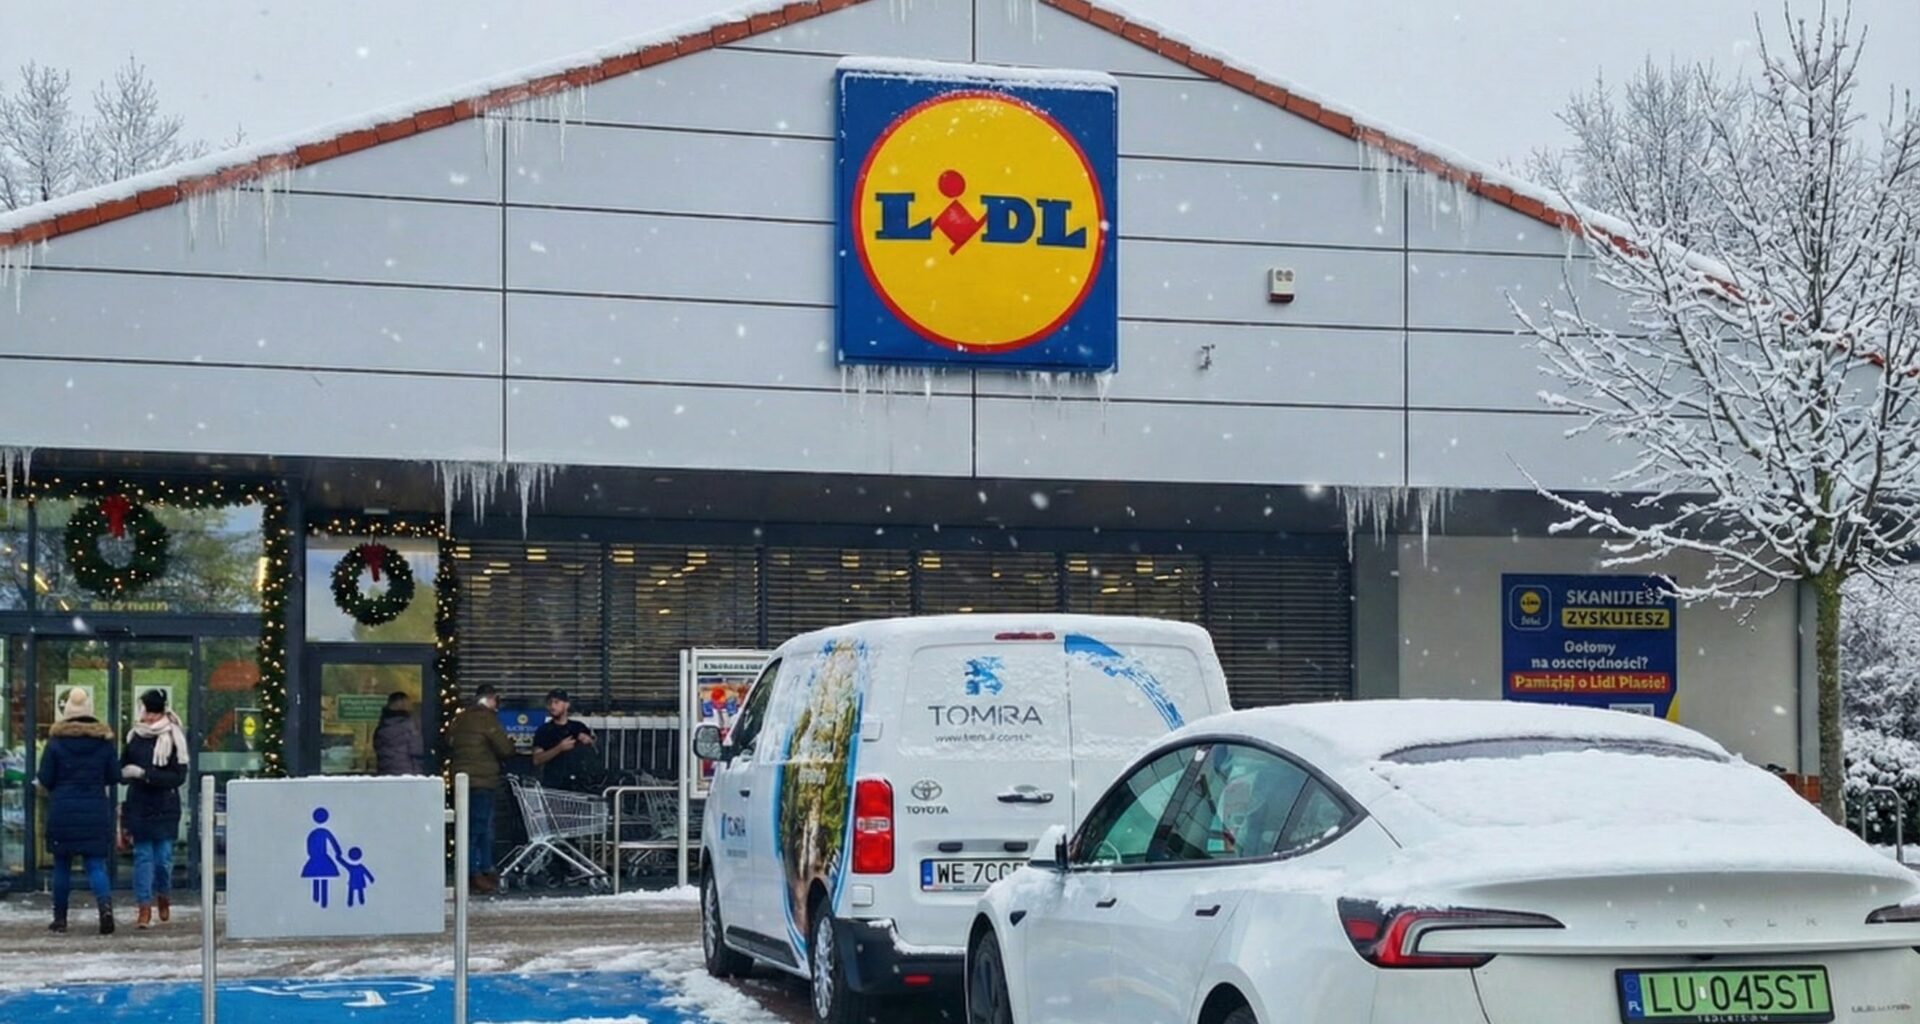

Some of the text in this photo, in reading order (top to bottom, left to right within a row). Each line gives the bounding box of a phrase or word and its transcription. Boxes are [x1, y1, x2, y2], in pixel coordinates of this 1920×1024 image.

[1531, 658, 1549, 669] na
[1578, 679, 1588, 689] o
[1590, 674, 1616, 689] Lidl
[927, 704, 1043, 727] TOMRA
[905, 805, 950, 815] TOYOTA
[936, 863, 965, 884] WE
[1648, 974, 1818, 1013] LU 045ST
